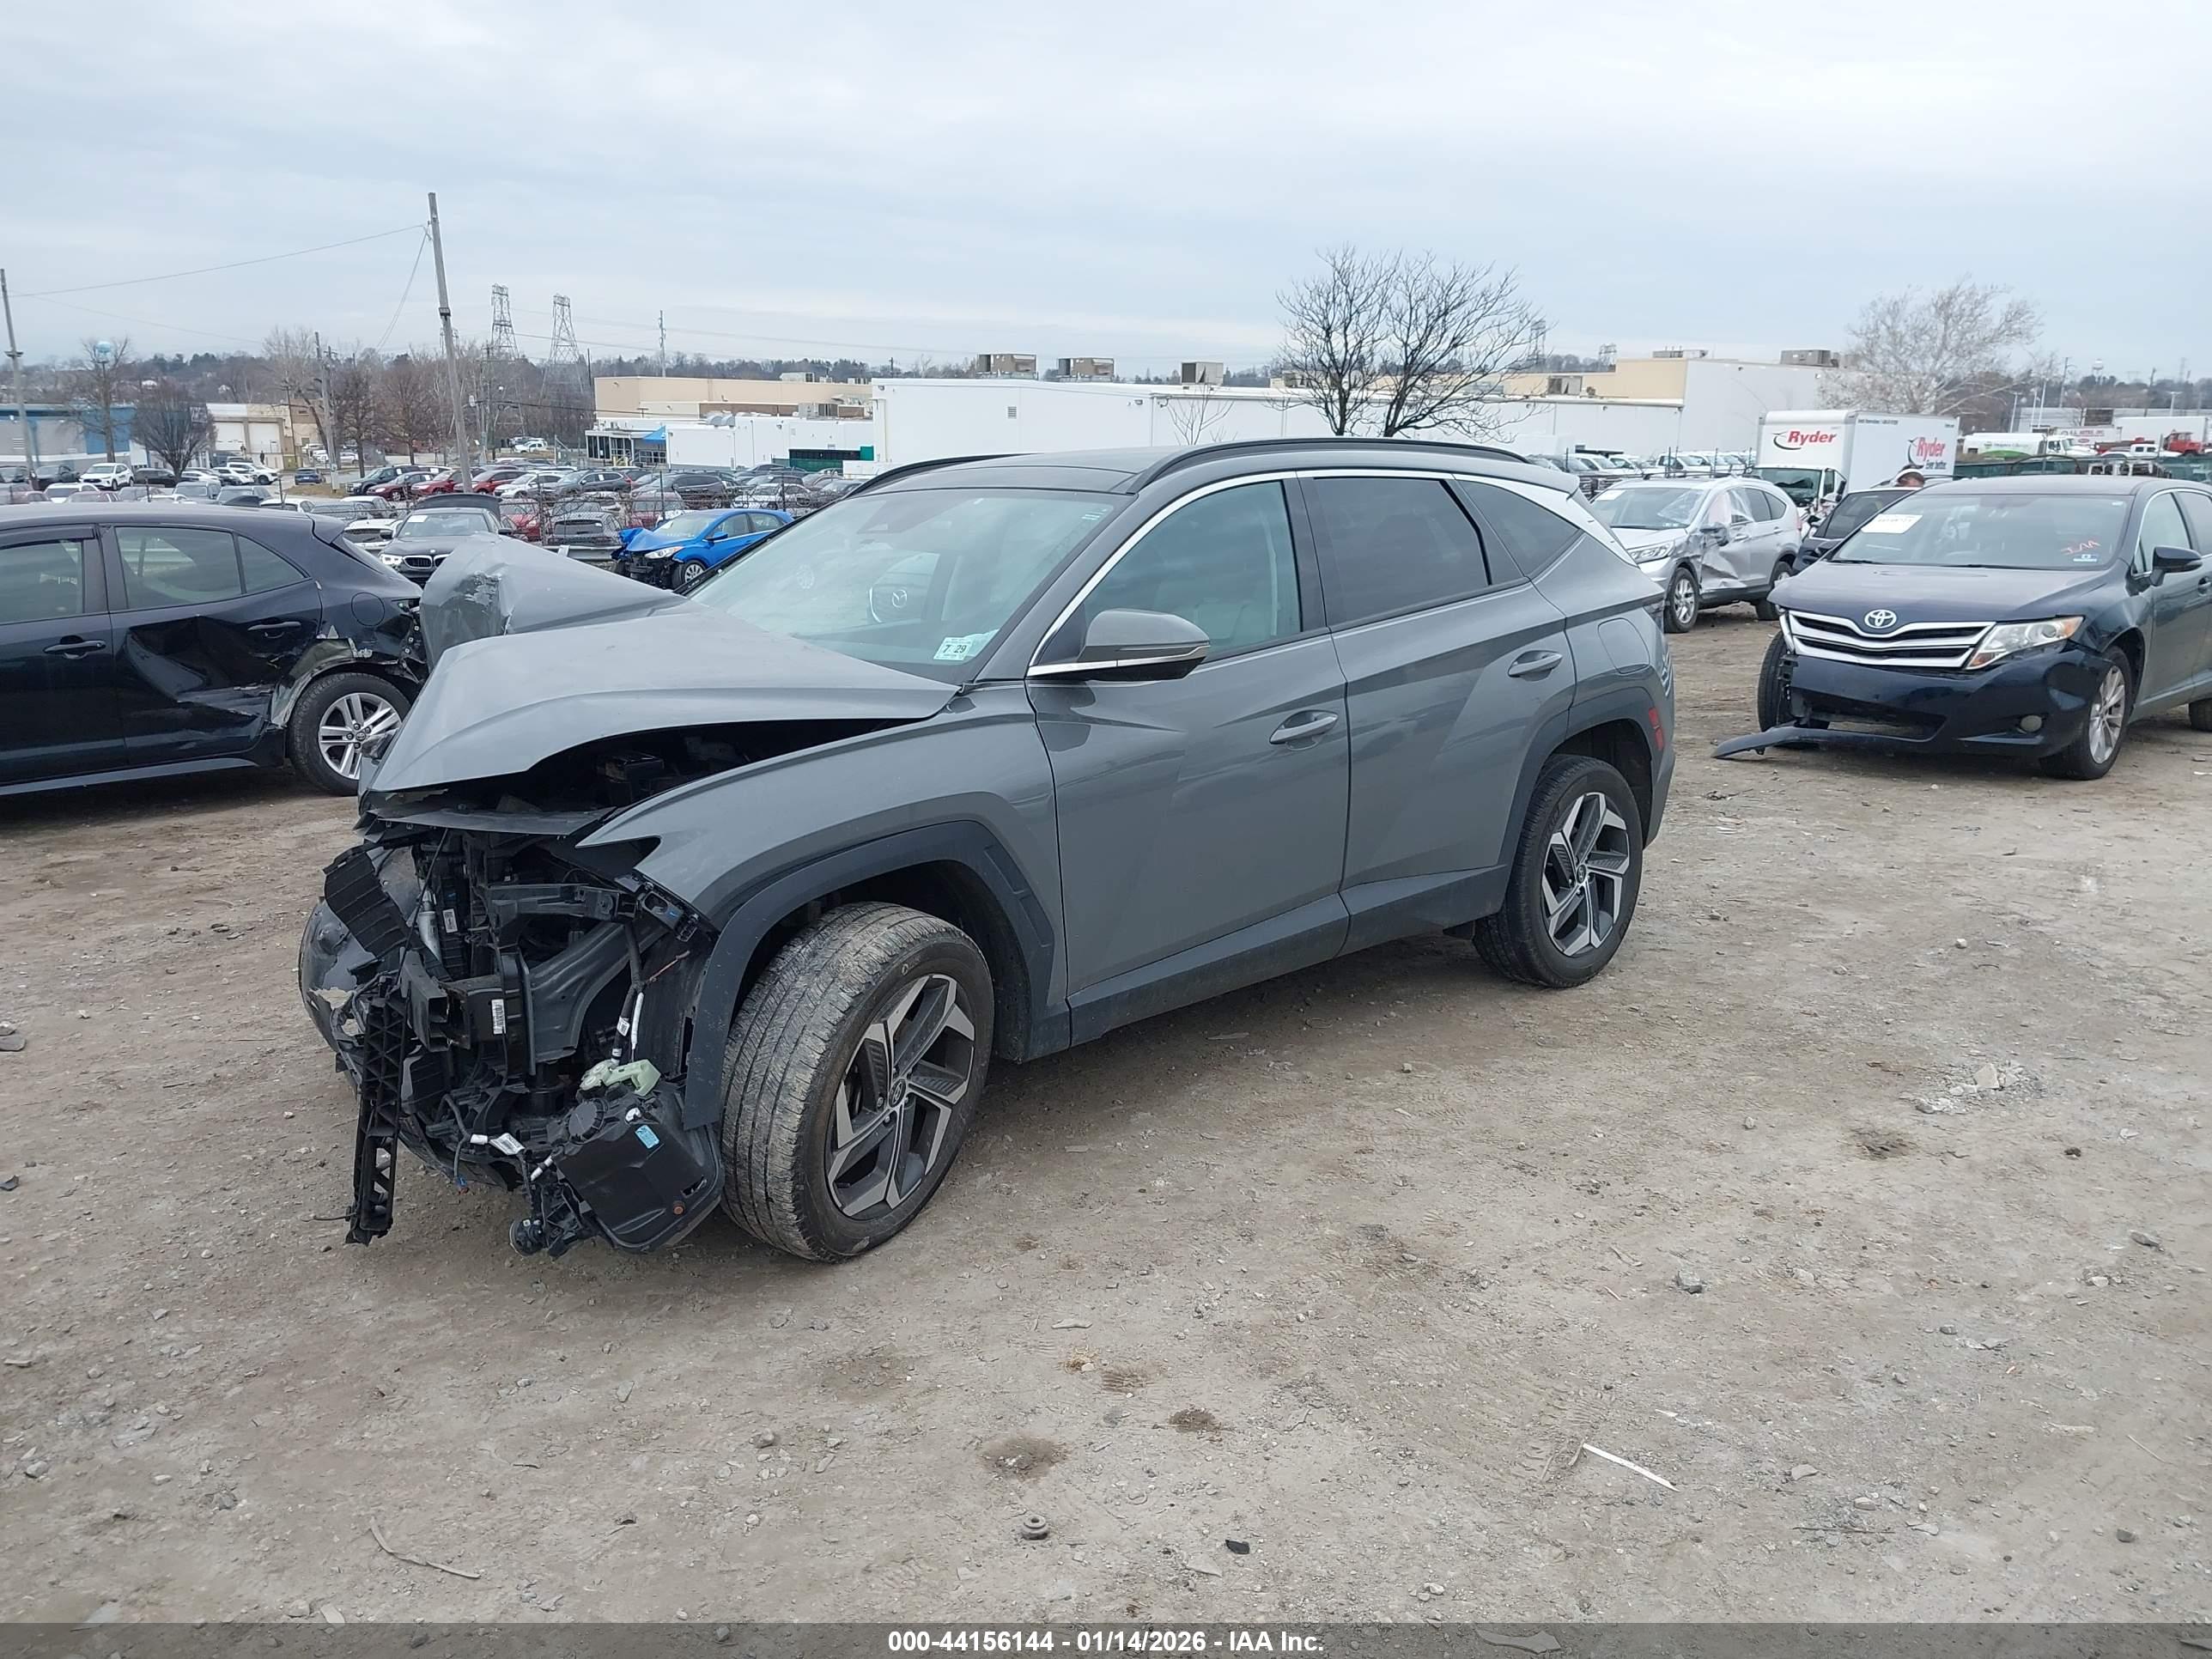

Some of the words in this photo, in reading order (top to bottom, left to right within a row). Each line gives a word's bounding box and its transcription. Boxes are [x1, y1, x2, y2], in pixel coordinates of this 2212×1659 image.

[1788, 430, 1837, 446] Ryder
[1917, 437, 1946, 461] Ryder
[953, 644, 967, 653] 29
